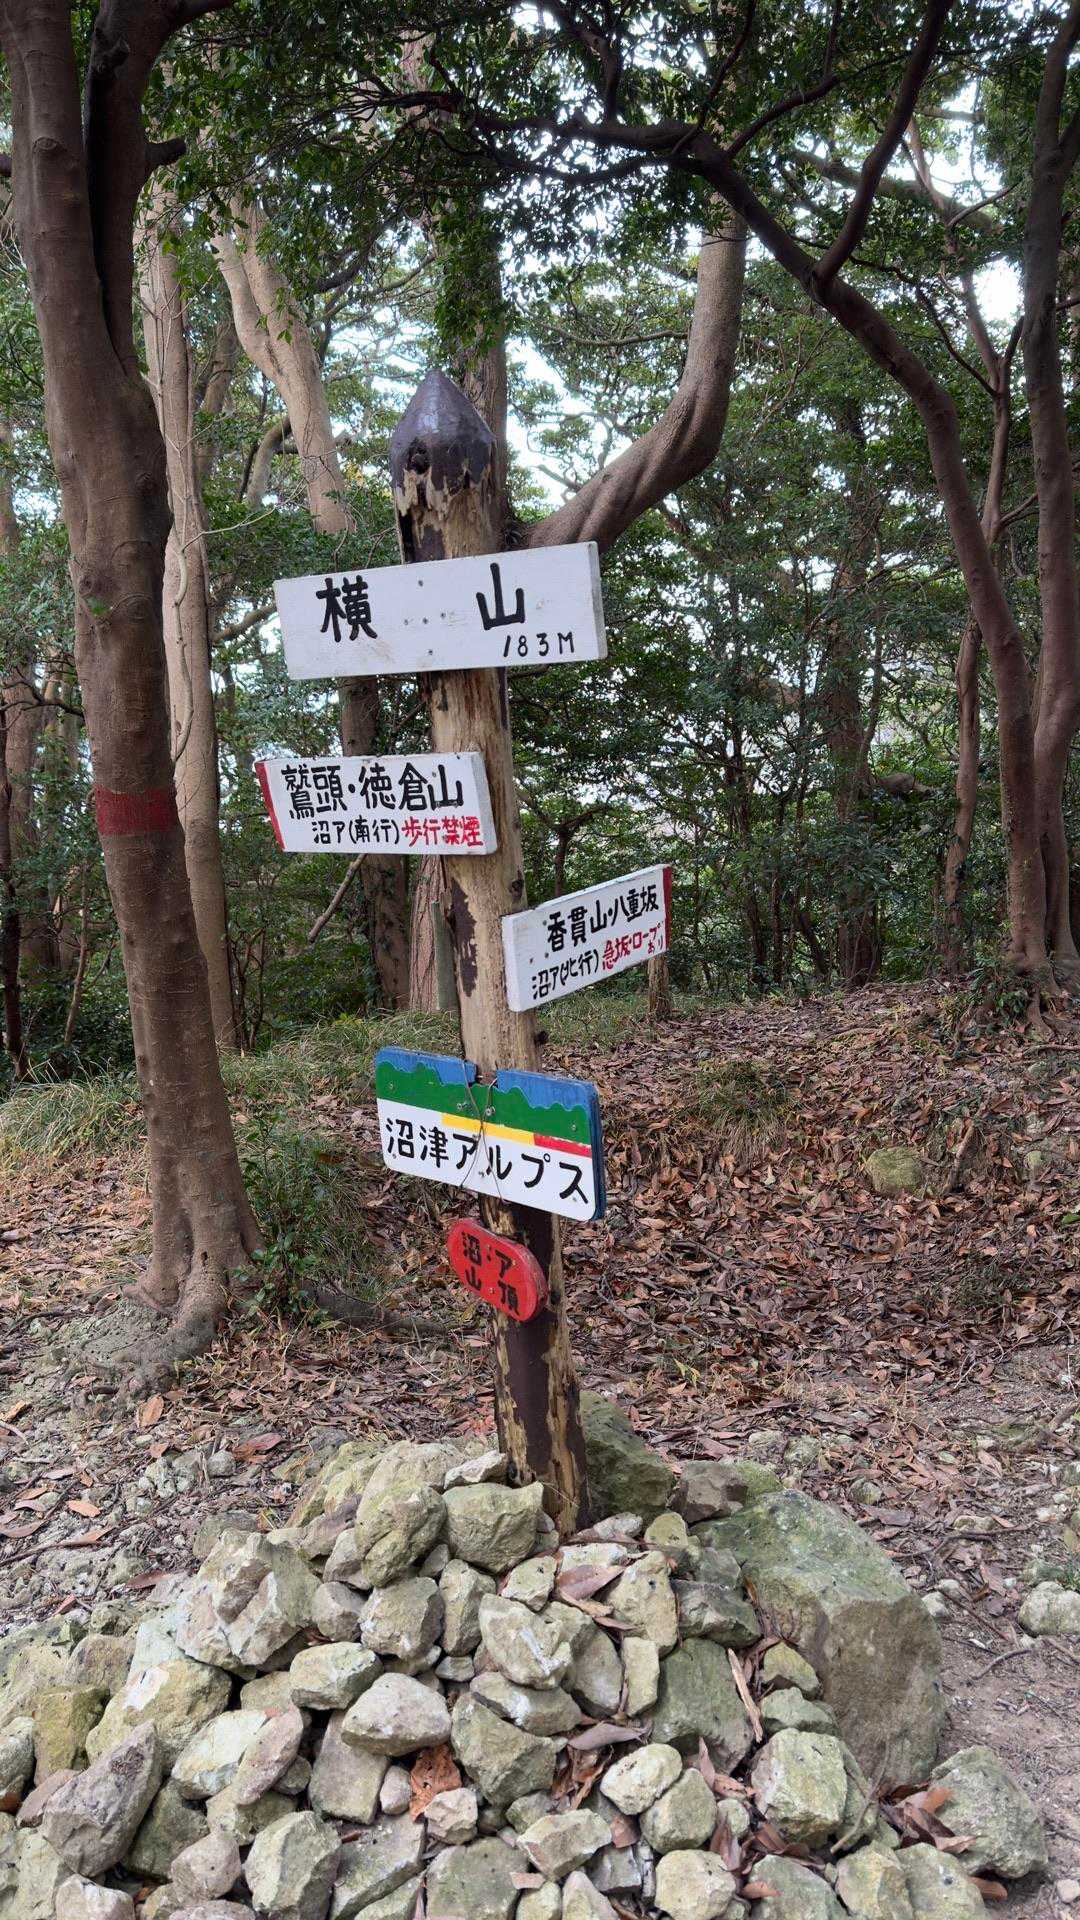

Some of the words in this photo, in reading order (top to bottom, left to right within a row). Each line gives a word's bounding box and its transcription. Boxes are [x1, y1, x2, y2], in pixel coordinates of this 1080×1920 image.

[315, 562, 526, 643] 横山
[502, 630, 575, 658] 183M
[547, 883, 659, 953] 香貫山・八重坂
[385, 1117, 589, 1205] 沼津アルプス
